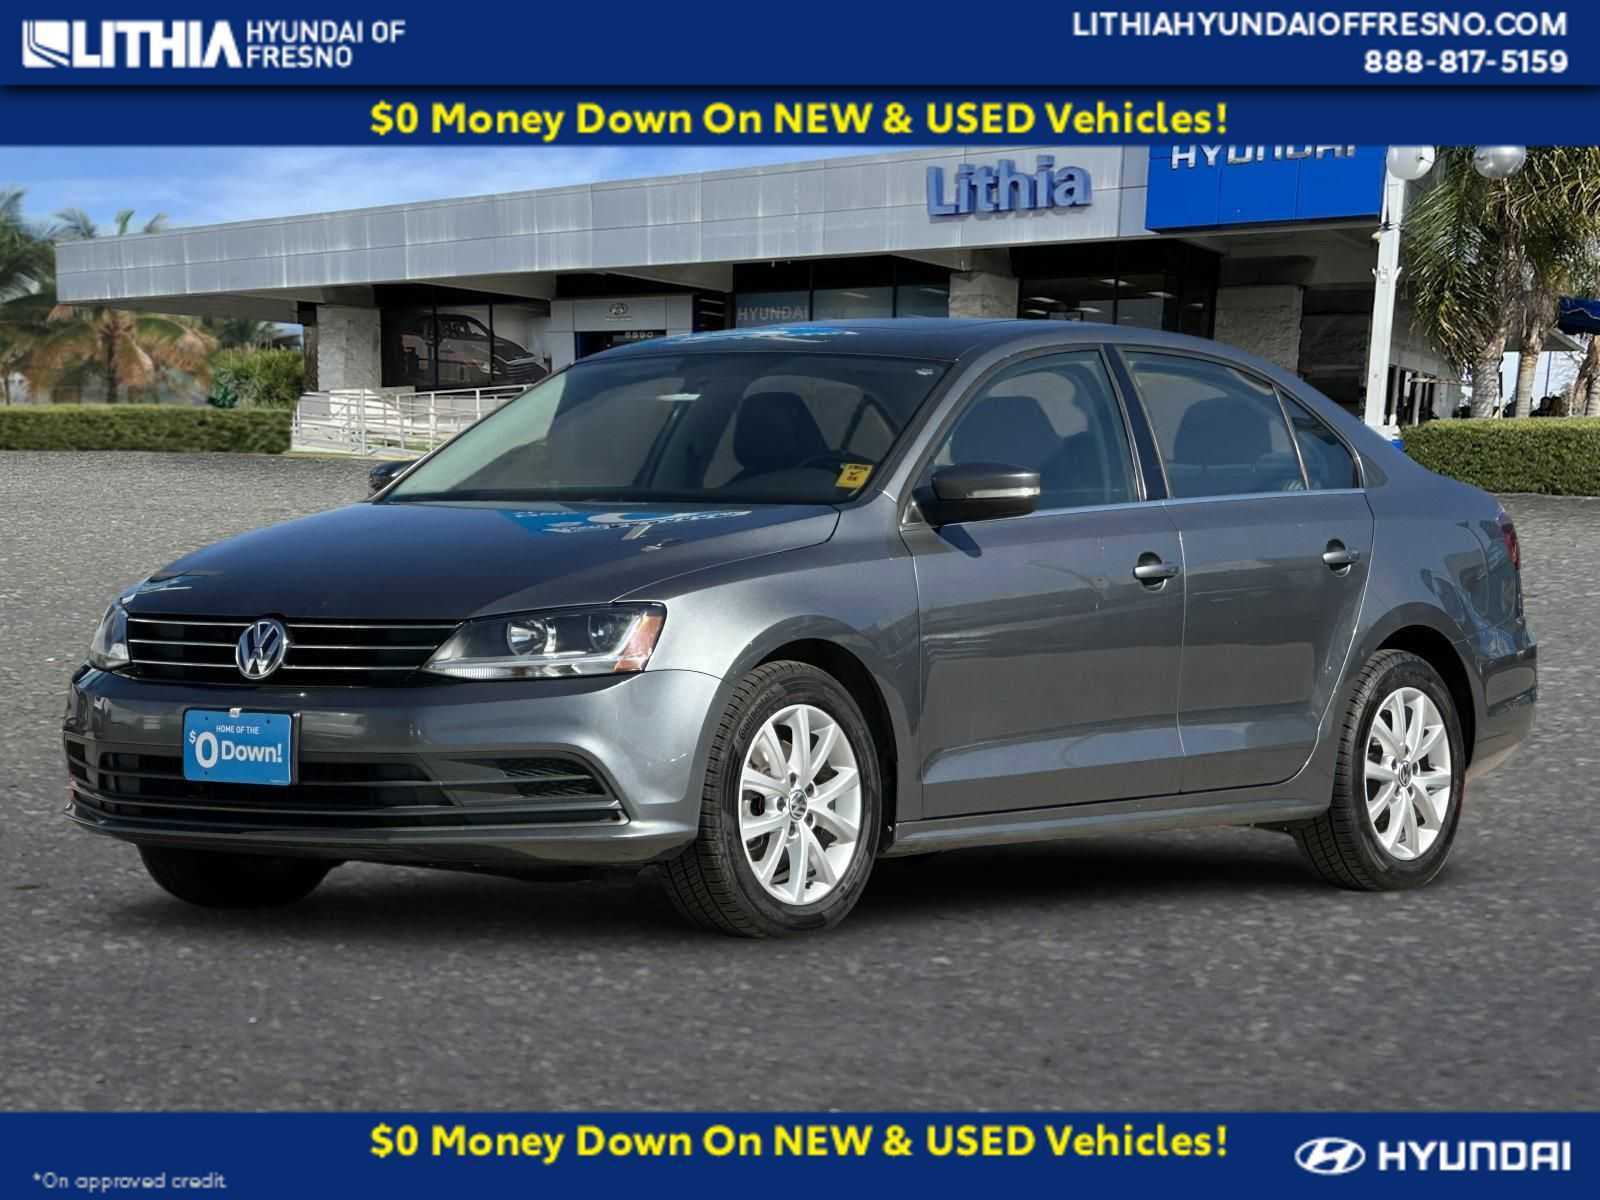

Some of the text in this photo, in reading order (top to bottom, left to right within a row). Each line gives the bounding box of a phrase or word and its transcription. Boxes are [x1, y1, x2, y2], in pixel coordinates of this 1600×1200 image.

[926, 154, 1091, 217] Lithia
[737, 306, 809, 321] HYUNDAI
[215, 725, 260, 735] HOME OF THE
[221, 740, 283, 764] Down!
